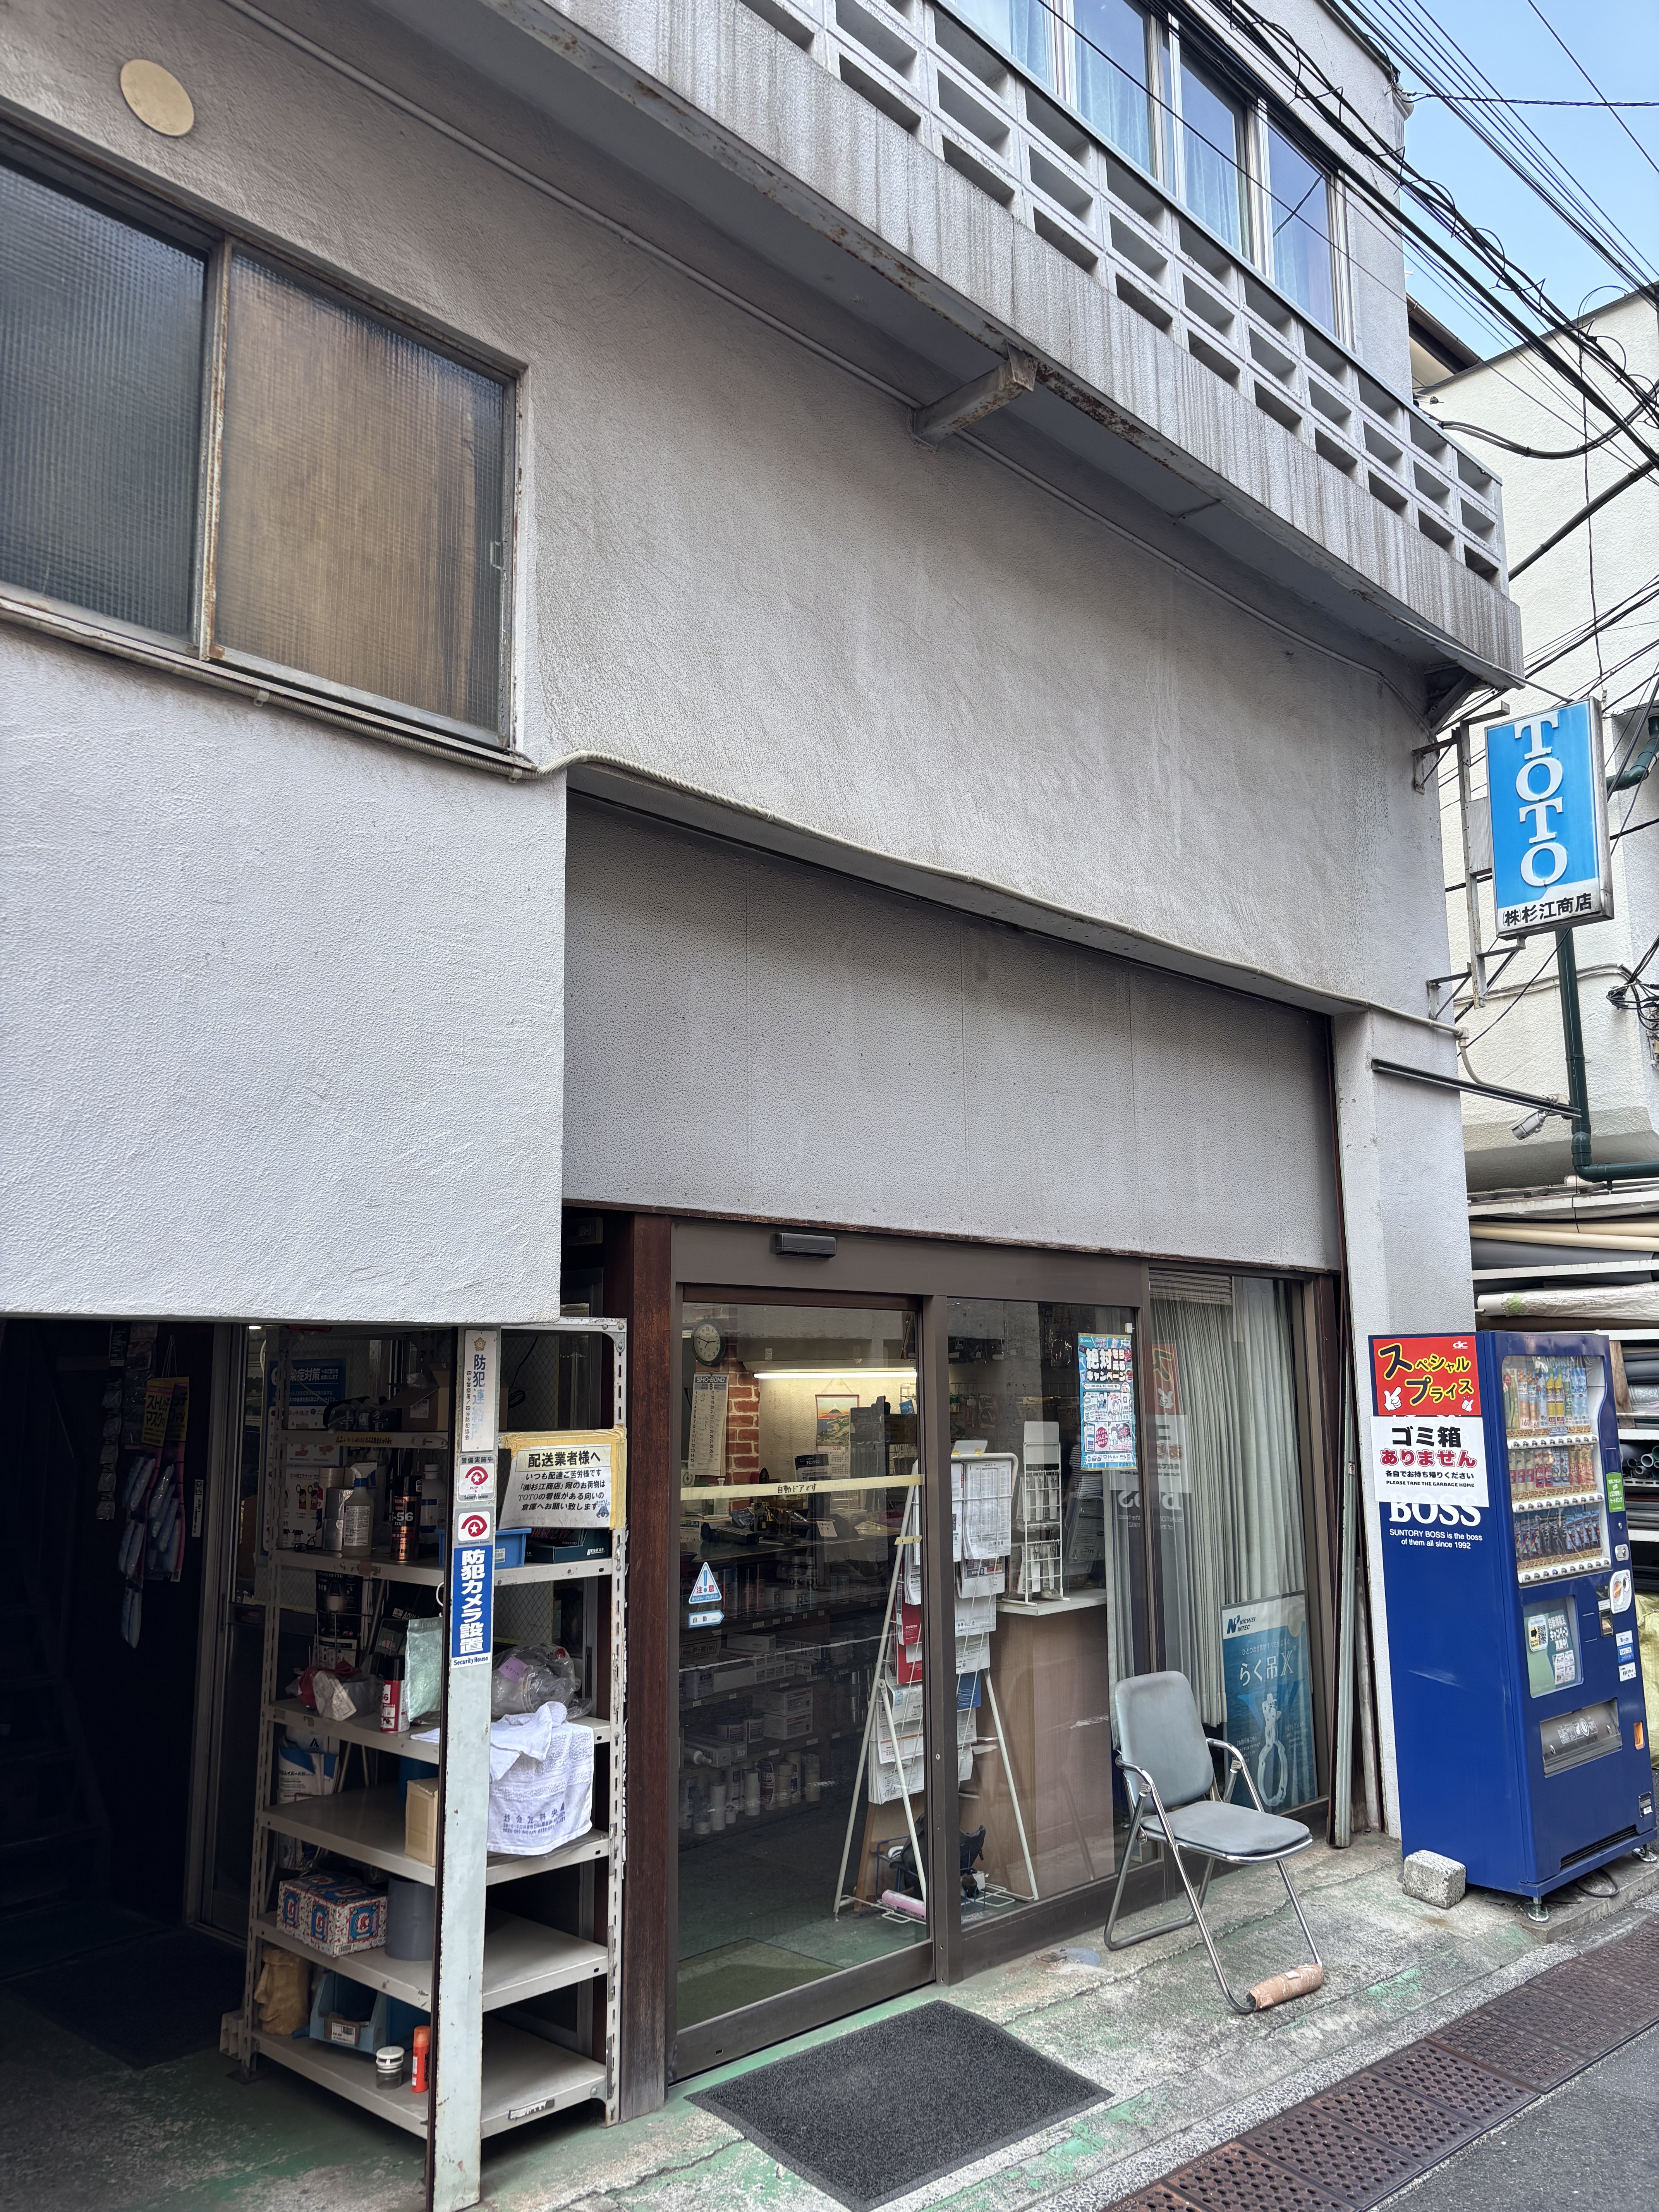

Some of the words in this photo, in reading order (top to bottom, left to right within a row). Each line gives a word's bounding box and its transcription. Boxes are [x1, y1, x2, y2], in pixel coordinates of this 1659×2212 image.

[1515, 711, 1567, 886] TOTO
[1086, 1348, 1112, 1370] 絶対
[1378, 1342, 1472, 1381] スペシャル
[284, 1368, 321, 1382] 染症対策
[1087, 1370, 1125, 1381] キャンペーン
[1404, 1374, 1474, 1406] プライス
[1392, 1426, 1461, 1448] ゴミ箱
[528, 1451, 601, 1468] 配送業者様へ
[1380, 1448, 1477, 1468] ありません
[526, 1469, 601, 1480] いつも配達ご苦労様です
[1386, 1470, 1474, 1479] 各自でお持ち帰りください
[778, 1483, 817, 1493] 自動ドアです
[519, 1492, 604, 1501] TOTOの看板がある向いの
[521, 1503, 597, 1511] 倉庫へお願い致します
[392, 1512, 414, 1522] -56
[1389, 1501, 1481, 1527] BOSS
[1389, 1528, 1423, 1537] SUNTORY
[1466, 1533, 1482, 1541] boss
[460, 1549, 485, 1654] 防犯カメラ設置
[1240, 1617, 1256, 1625] NICHIEI
[454, 1657, 473, 1666] Security
[474, 1655, 488, 1663] House
